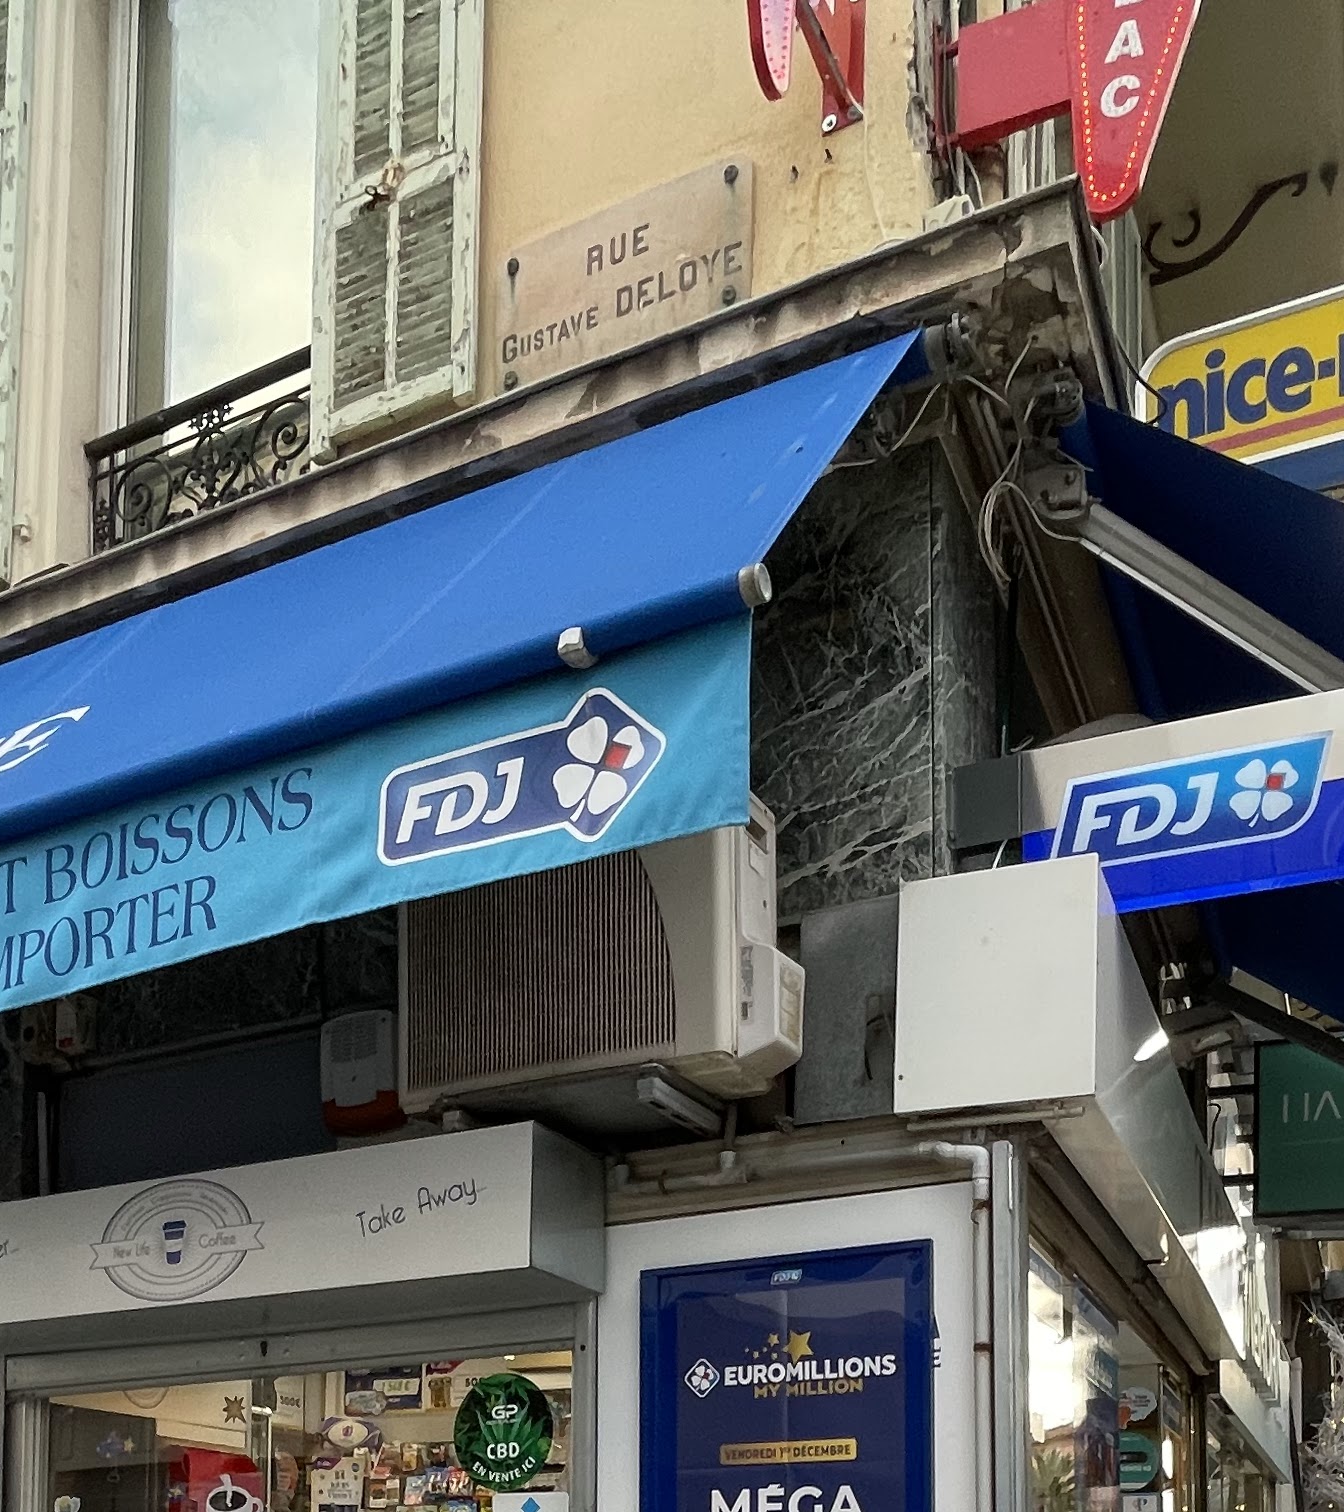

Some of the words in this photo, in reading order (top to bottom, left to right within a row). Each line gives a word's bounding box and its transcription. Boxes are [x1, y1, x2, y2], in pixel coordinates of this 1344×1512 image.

[585, 222, 651, 276] RUE
[502, 302, 599, 366] GUSTAVE
[614, 239, 743, 317] DELOYE
[395, 756, 524, 844] FDJ
[1073, 772, 1221, 854] FDJ
[44, 766, 315, 908] BOISSONS
[355, 1203, 407, 1239] Take
[198, 1231, 237, 1249] Coffee
[723, 1353, 897, 1387] EUROMILLIONS
[753, 1383, 780, 1399] MY
[786, 1378, 864, 1398] MILLION
[491, 1403, 519, 1420] GP
[486, 1442, 520, 1460] CBD
[724, 1448, 777, 1461] VENDREDI
[792, 1443, 851, 1459] DÉCEMBRE
[472, 1461, 488, 1477] EN
[488, 1467, 522, 1482] VENTE
[521, 1455, 536, 1474] ICI
